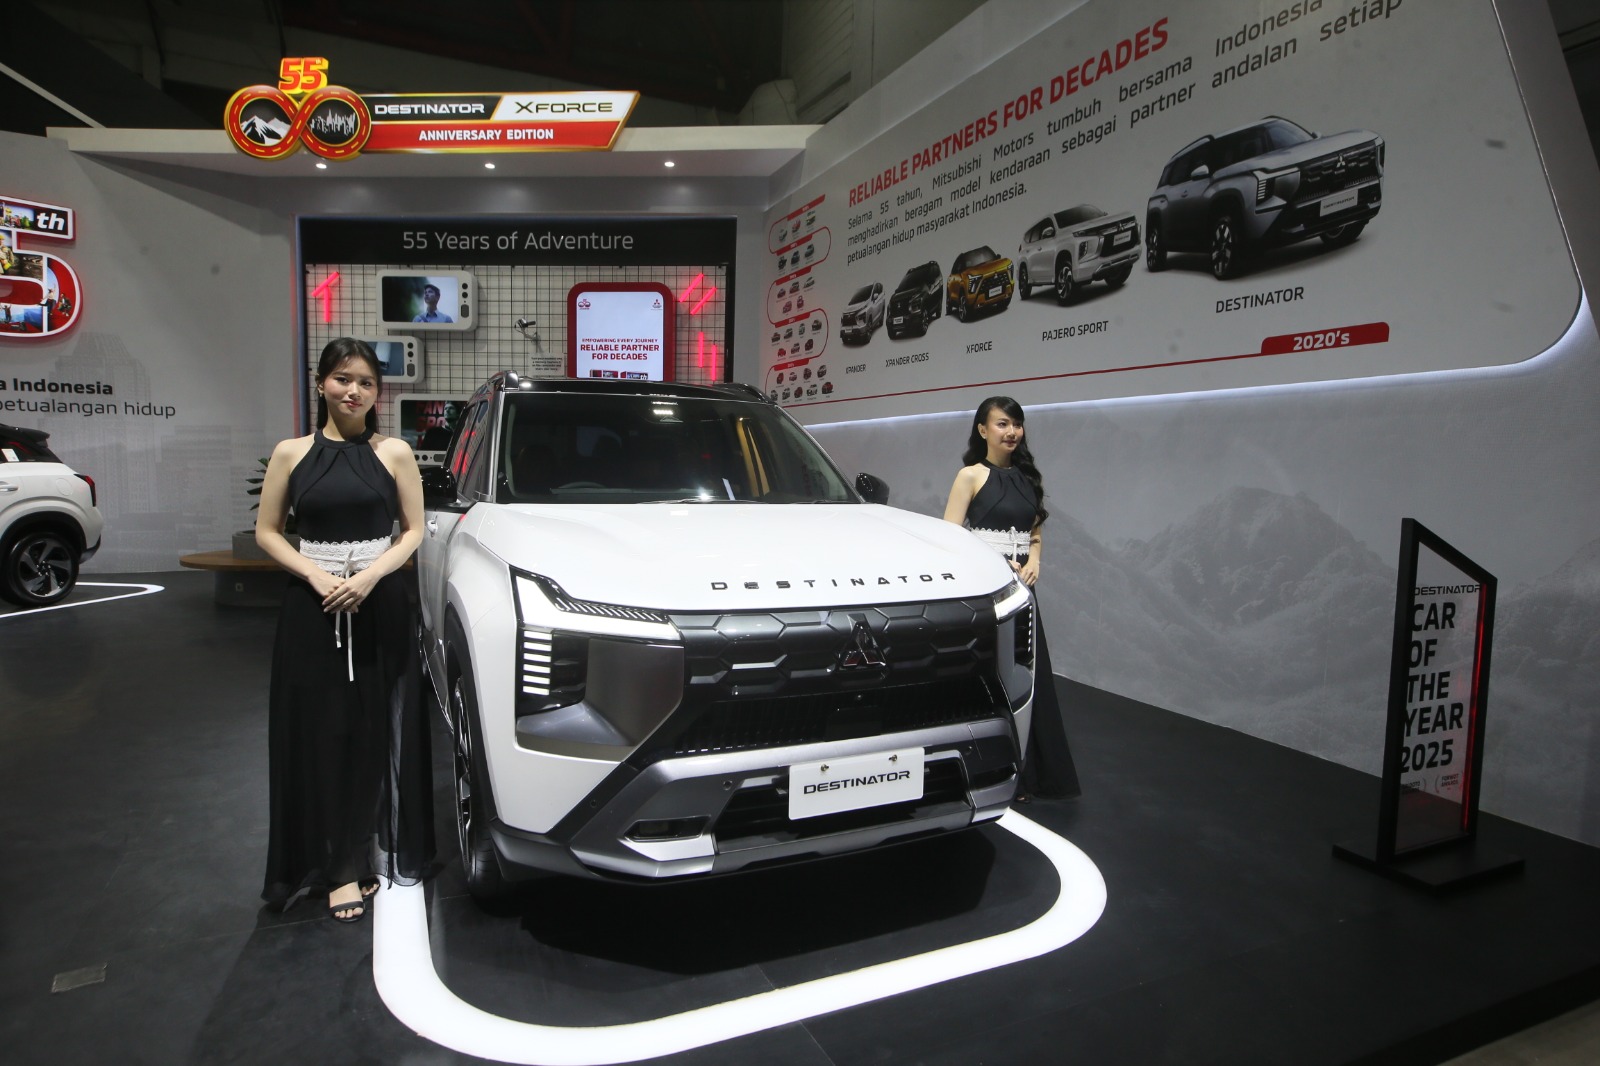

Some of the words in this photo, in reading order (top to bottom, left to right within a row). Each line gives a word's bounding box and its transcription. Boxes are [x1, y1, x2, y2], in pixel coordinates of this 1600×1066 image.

[279, 57, 323, 91] 55
[374, 103, 485, 115] DESTINATOR
[514, 101, 613, 114] XFORCE
[848, 159, 909, 208] RELIABLE
[911, 109, 998, 175] PARTNERS
[1003, 86, 1044, 128] FOR
[1049, 16, 1168, 105] DECADES
[418, 129, 502, 141] ANNIVERSARY
[506, 128, 554, 140] EDITION
[847, 217, 899, 247] menghadirkan
[904, 197, 943, 222] beragam
[950, 176, 981, 202] model
[990, 148, 1050, 185] kendaraan
[1061, 115, 1117, 154] sebagai
[1130, 82, 1196, 128] partner
[1212, 37, 1298, 88] andalan
[848, 210, 873, 229] Selama
[880, 200, 889, 215] 55
[897, 186, 923, 207] tahun,
[932, 154, 982, 190] Mitsubishi
[993, 131, 1034, 161] Motors
[1046, 98, 1101, 136] tumbuh
[1119, 54, 1193, 103] bersama
[36, 212, 65, 231] th
[847, 237, 891, 266] petualangan
[892, 227, 915, 247] hidup
[916, 203, 970, 235] masyarakat
[972, 182, 1027, 214] Indonesia.
[402, 231, 428, 249] 55
[434, 231, 490, 249] Years
[496, 231, 518, 249] of
[524, 231, 634, 249] Adventure
[1215, 286, 1305, 314] DESTINATOR
[1042, 326, 1076, 342] PAJERO
[1077, 320, 1109, 336] SPORT
[1292, 330, 1350, 352] 2020's
[885, 355, 910, 368] XPANDER
[910, 352, 930, 364] CROSS
[966, 340, 993, 355] XFORCE
[13, 378, 113, 395] Indonesia
[124, 401, 176, 418] hidup
[710, 572, 956, 590] DESTINATOR
[1412, 602, 1456, 631] CAR
[1409, 638, 1438, 668] OF
[1407, 671, 1451, 703] THE
[1404, 702, 1463, 737] YEAR
[1400, 738, 1454, 773] 2025
[803, 769, 911, 795] DESTINATOR
